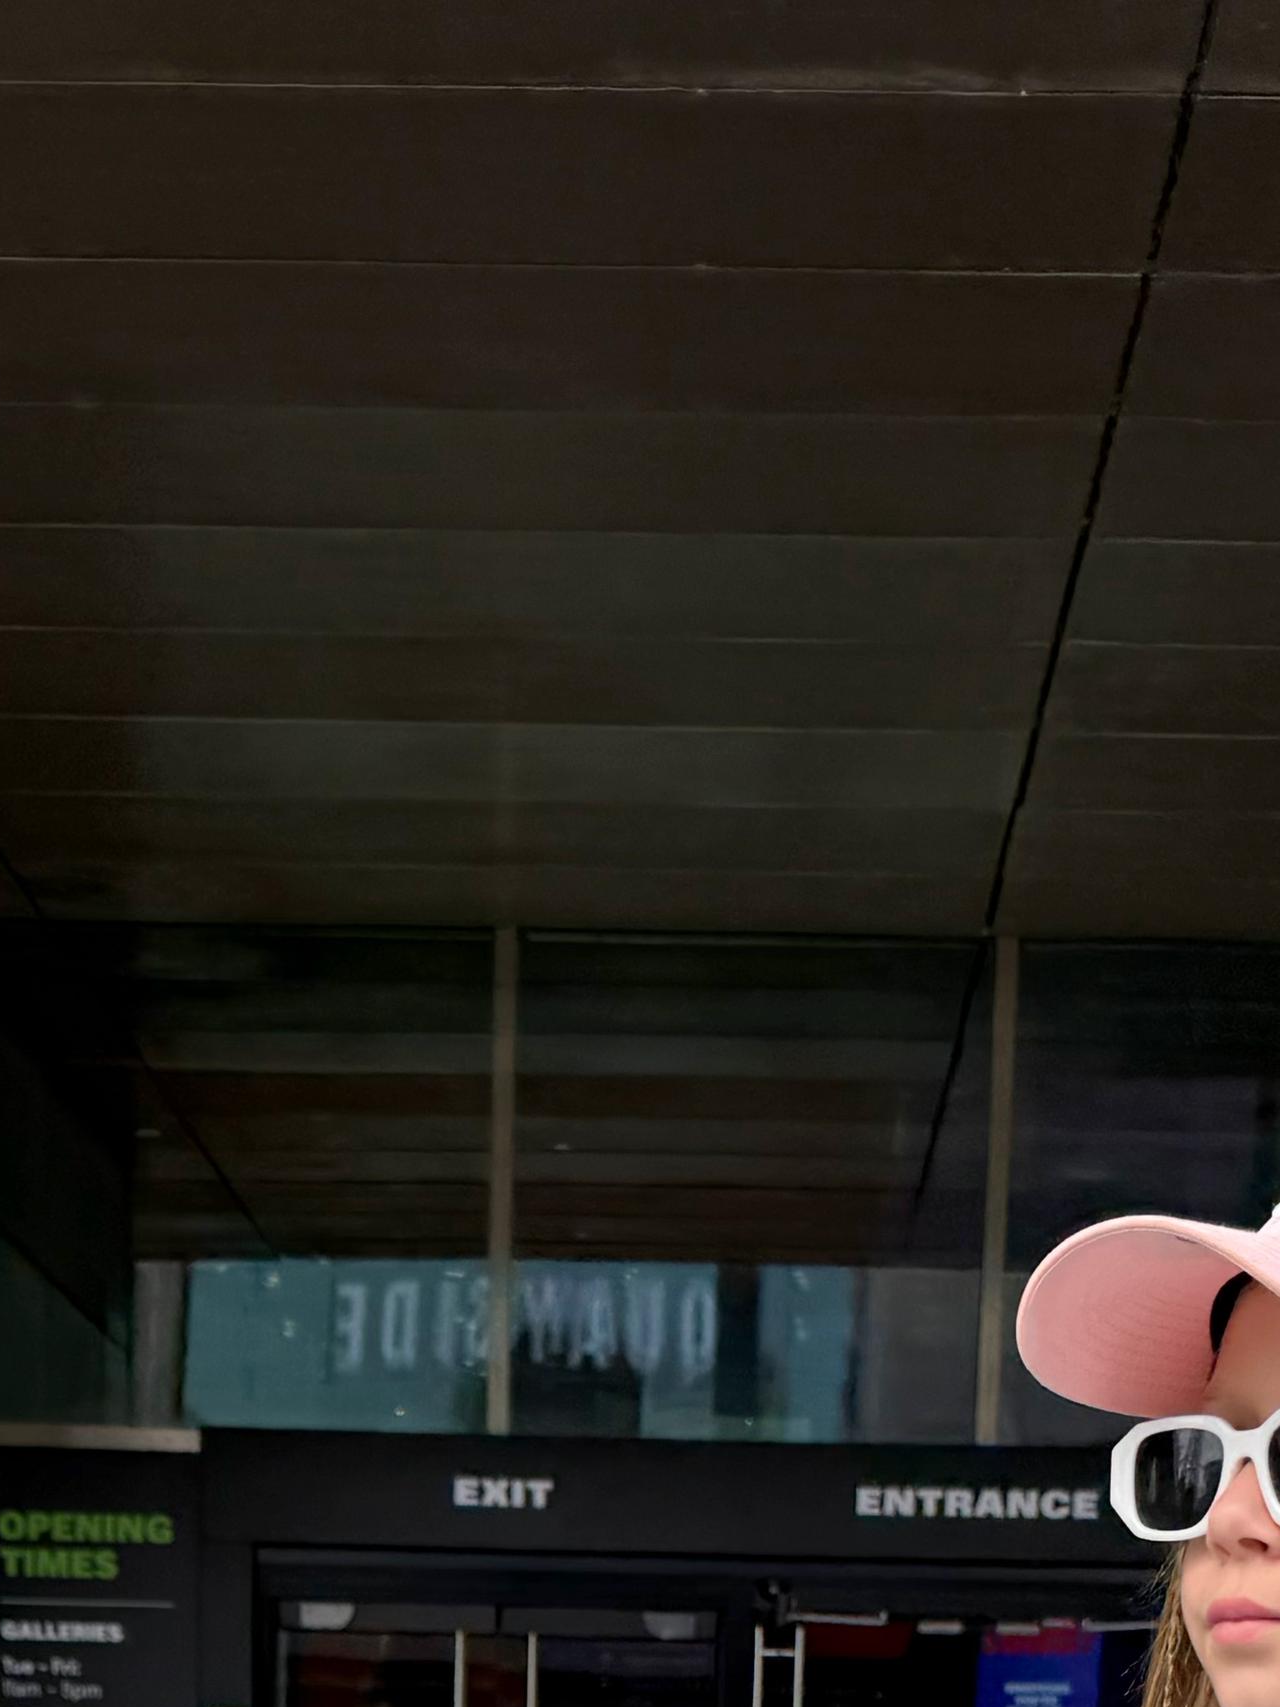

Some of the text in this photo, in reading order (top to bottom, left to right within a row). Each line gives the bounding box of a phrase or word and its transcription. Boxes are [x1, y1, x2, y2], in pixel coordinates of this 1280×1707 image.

[452, 1474, 555, 1510] EXIT
[854, 1484, 1100, 1520] ENTRANCE
[0, 1545, 119, 1581] TIMES
[0, 1618, 125, 1643] GALLERIES
